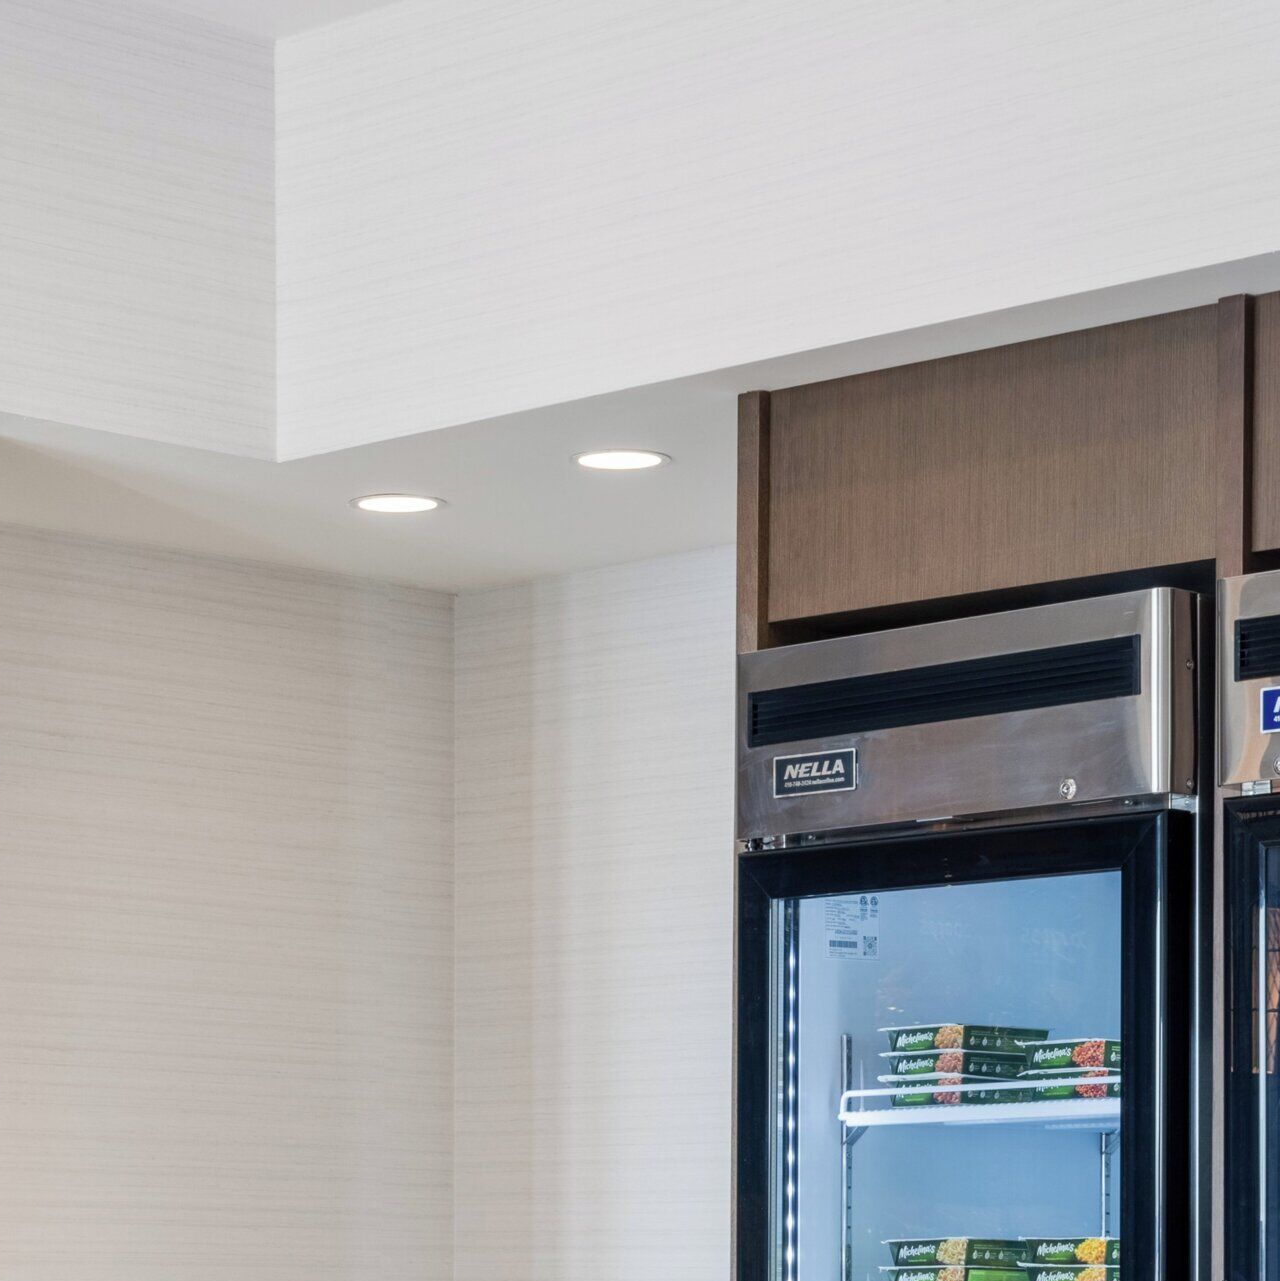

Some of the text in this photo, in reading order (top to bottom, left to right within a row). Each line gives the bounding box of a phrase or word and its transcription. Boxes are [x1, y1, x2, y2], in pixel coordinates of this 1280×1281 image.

[783, 759, 845, 780] NELLA
[897, 1031, 933, 1048] Michelina's
[1033, 1046, 1072, 1063] Michelina's
[897, 1058, 934, 1073] Michelina's
[899, 1244, 936, 1259] Michelina's
[1037, 1242, 1075, 1256] Michelina's
